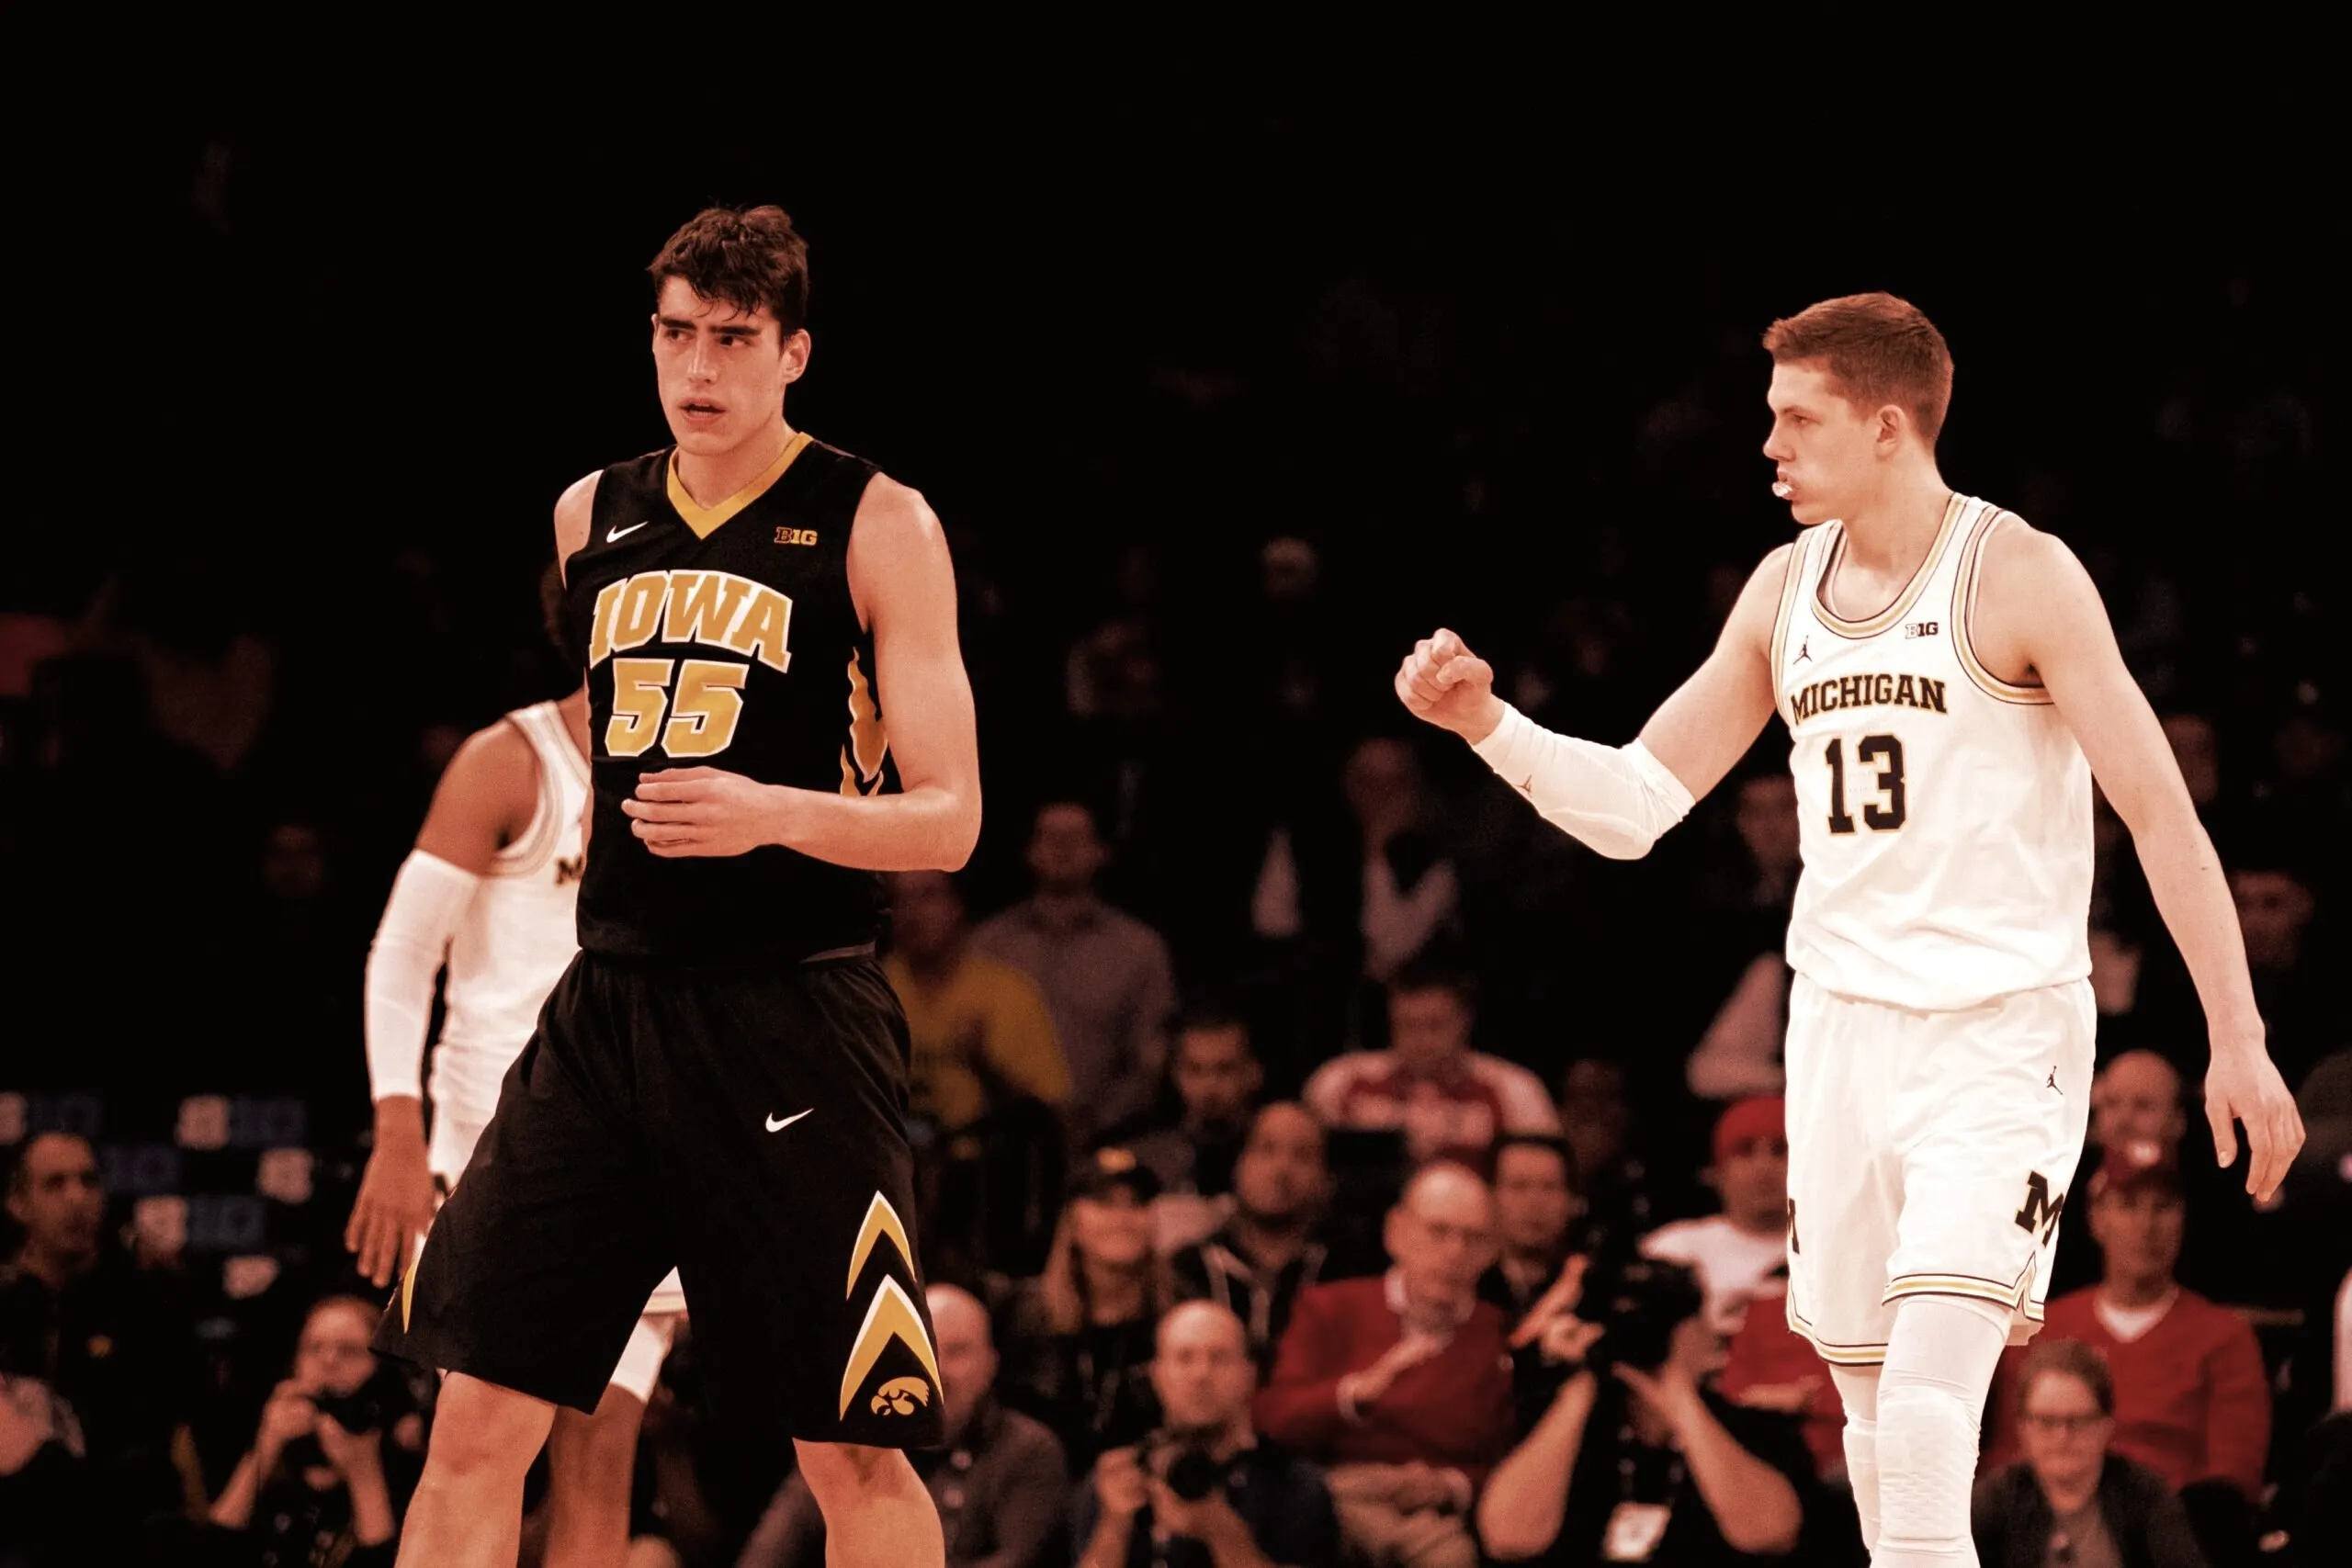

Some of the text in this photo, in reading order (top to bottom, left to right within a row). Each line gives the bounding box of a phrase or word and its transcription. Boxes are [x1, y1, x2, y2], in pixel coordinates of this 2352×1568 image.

[589, 569, 794, 674] IOWA
[604, 657, 751, 759] 55
[1790, 673, 1949, 726] MICHIGAN
[1825, 734, 1907, 835] 13
